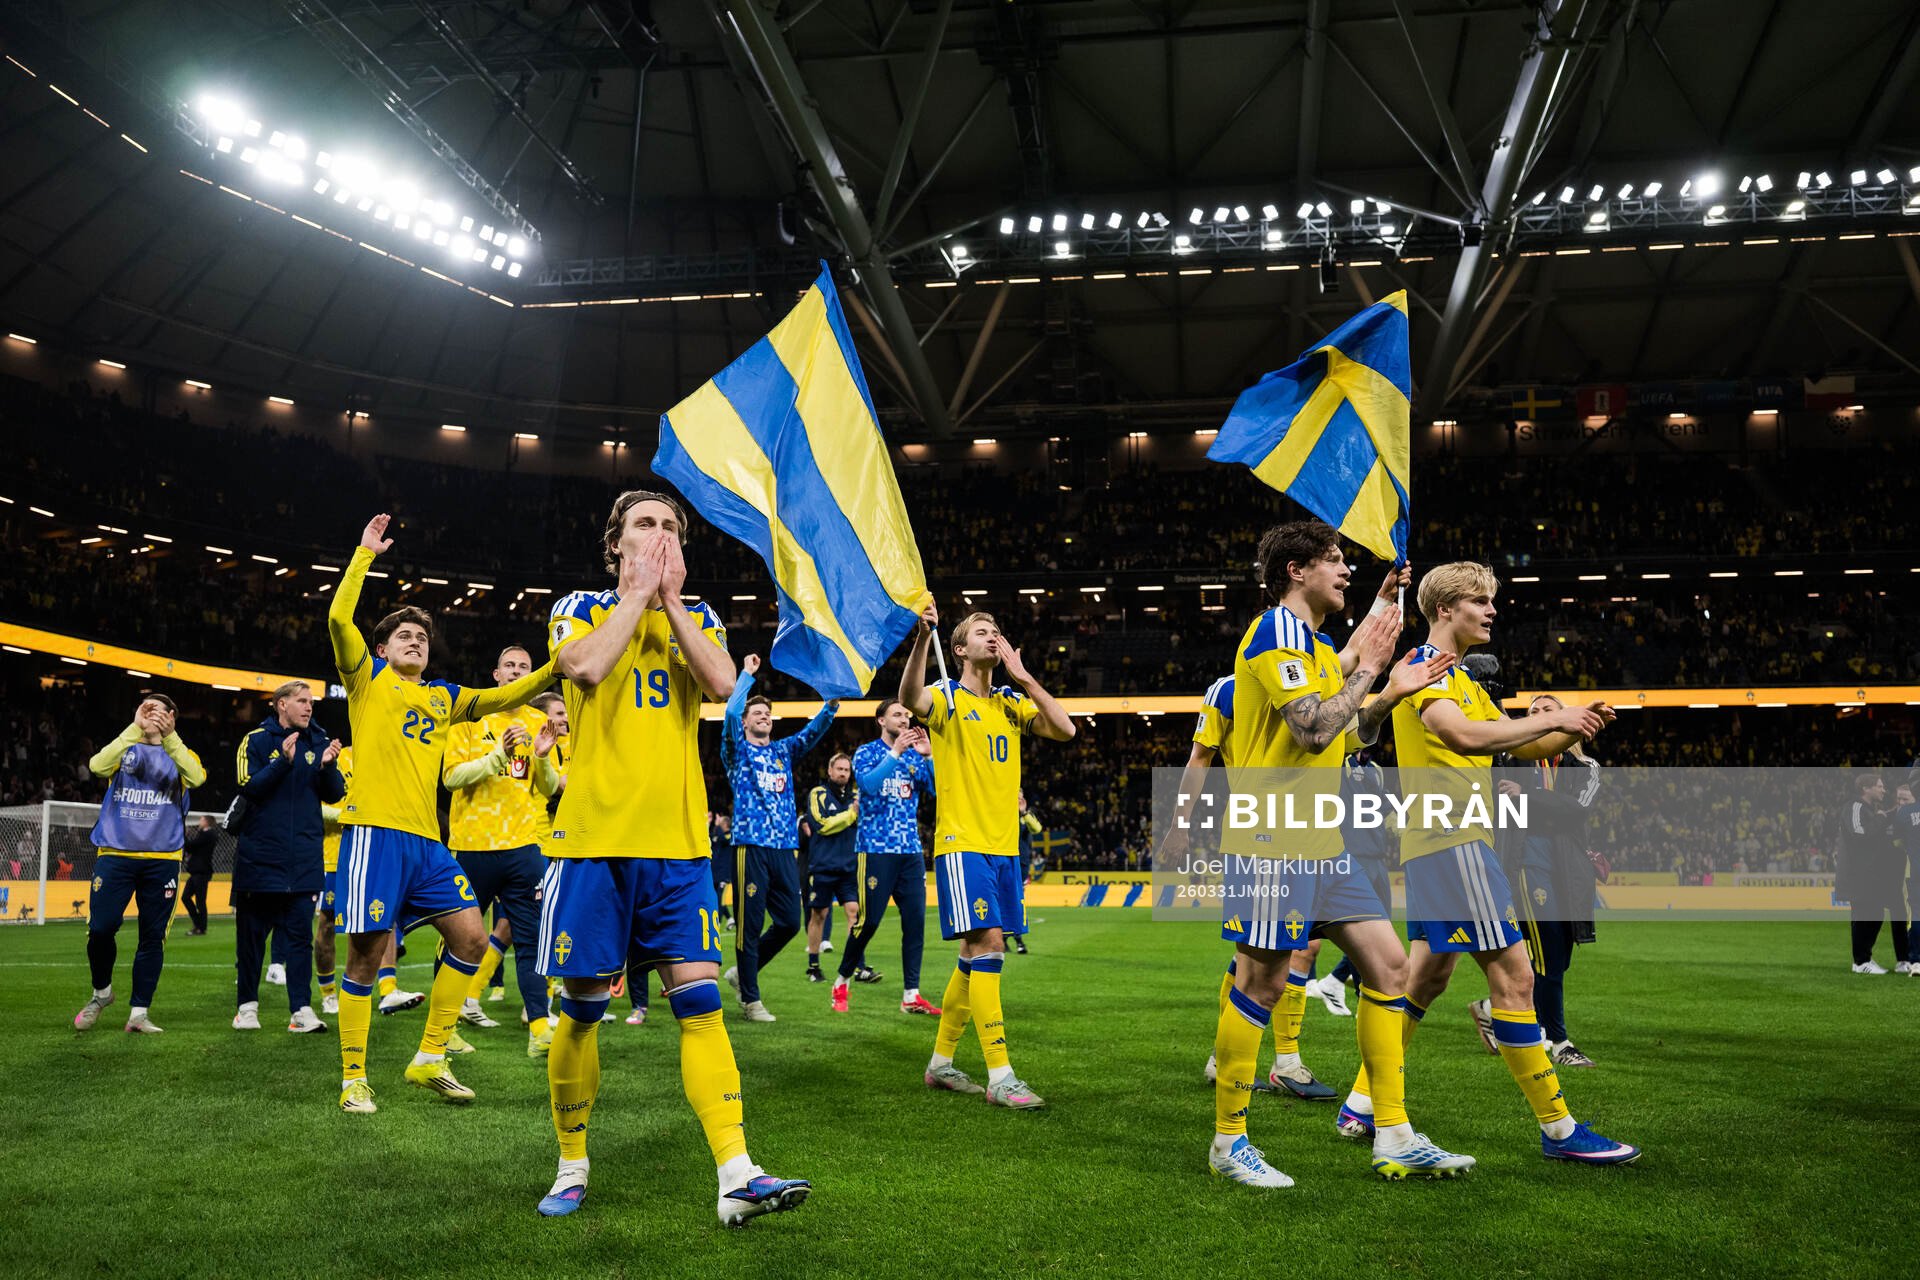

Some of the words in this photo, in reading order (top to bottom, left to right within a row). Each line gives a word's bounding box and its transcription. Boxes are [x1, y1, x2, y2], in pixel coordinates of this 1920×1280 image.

[633, 667, 670, 708] 19
[402, 709, 435, 745] 22
[987, 733, 1009, 763] 10
[129, 808, 159, 818] RESPECT
[554, 1099, 590, 1112] SVERIGE
